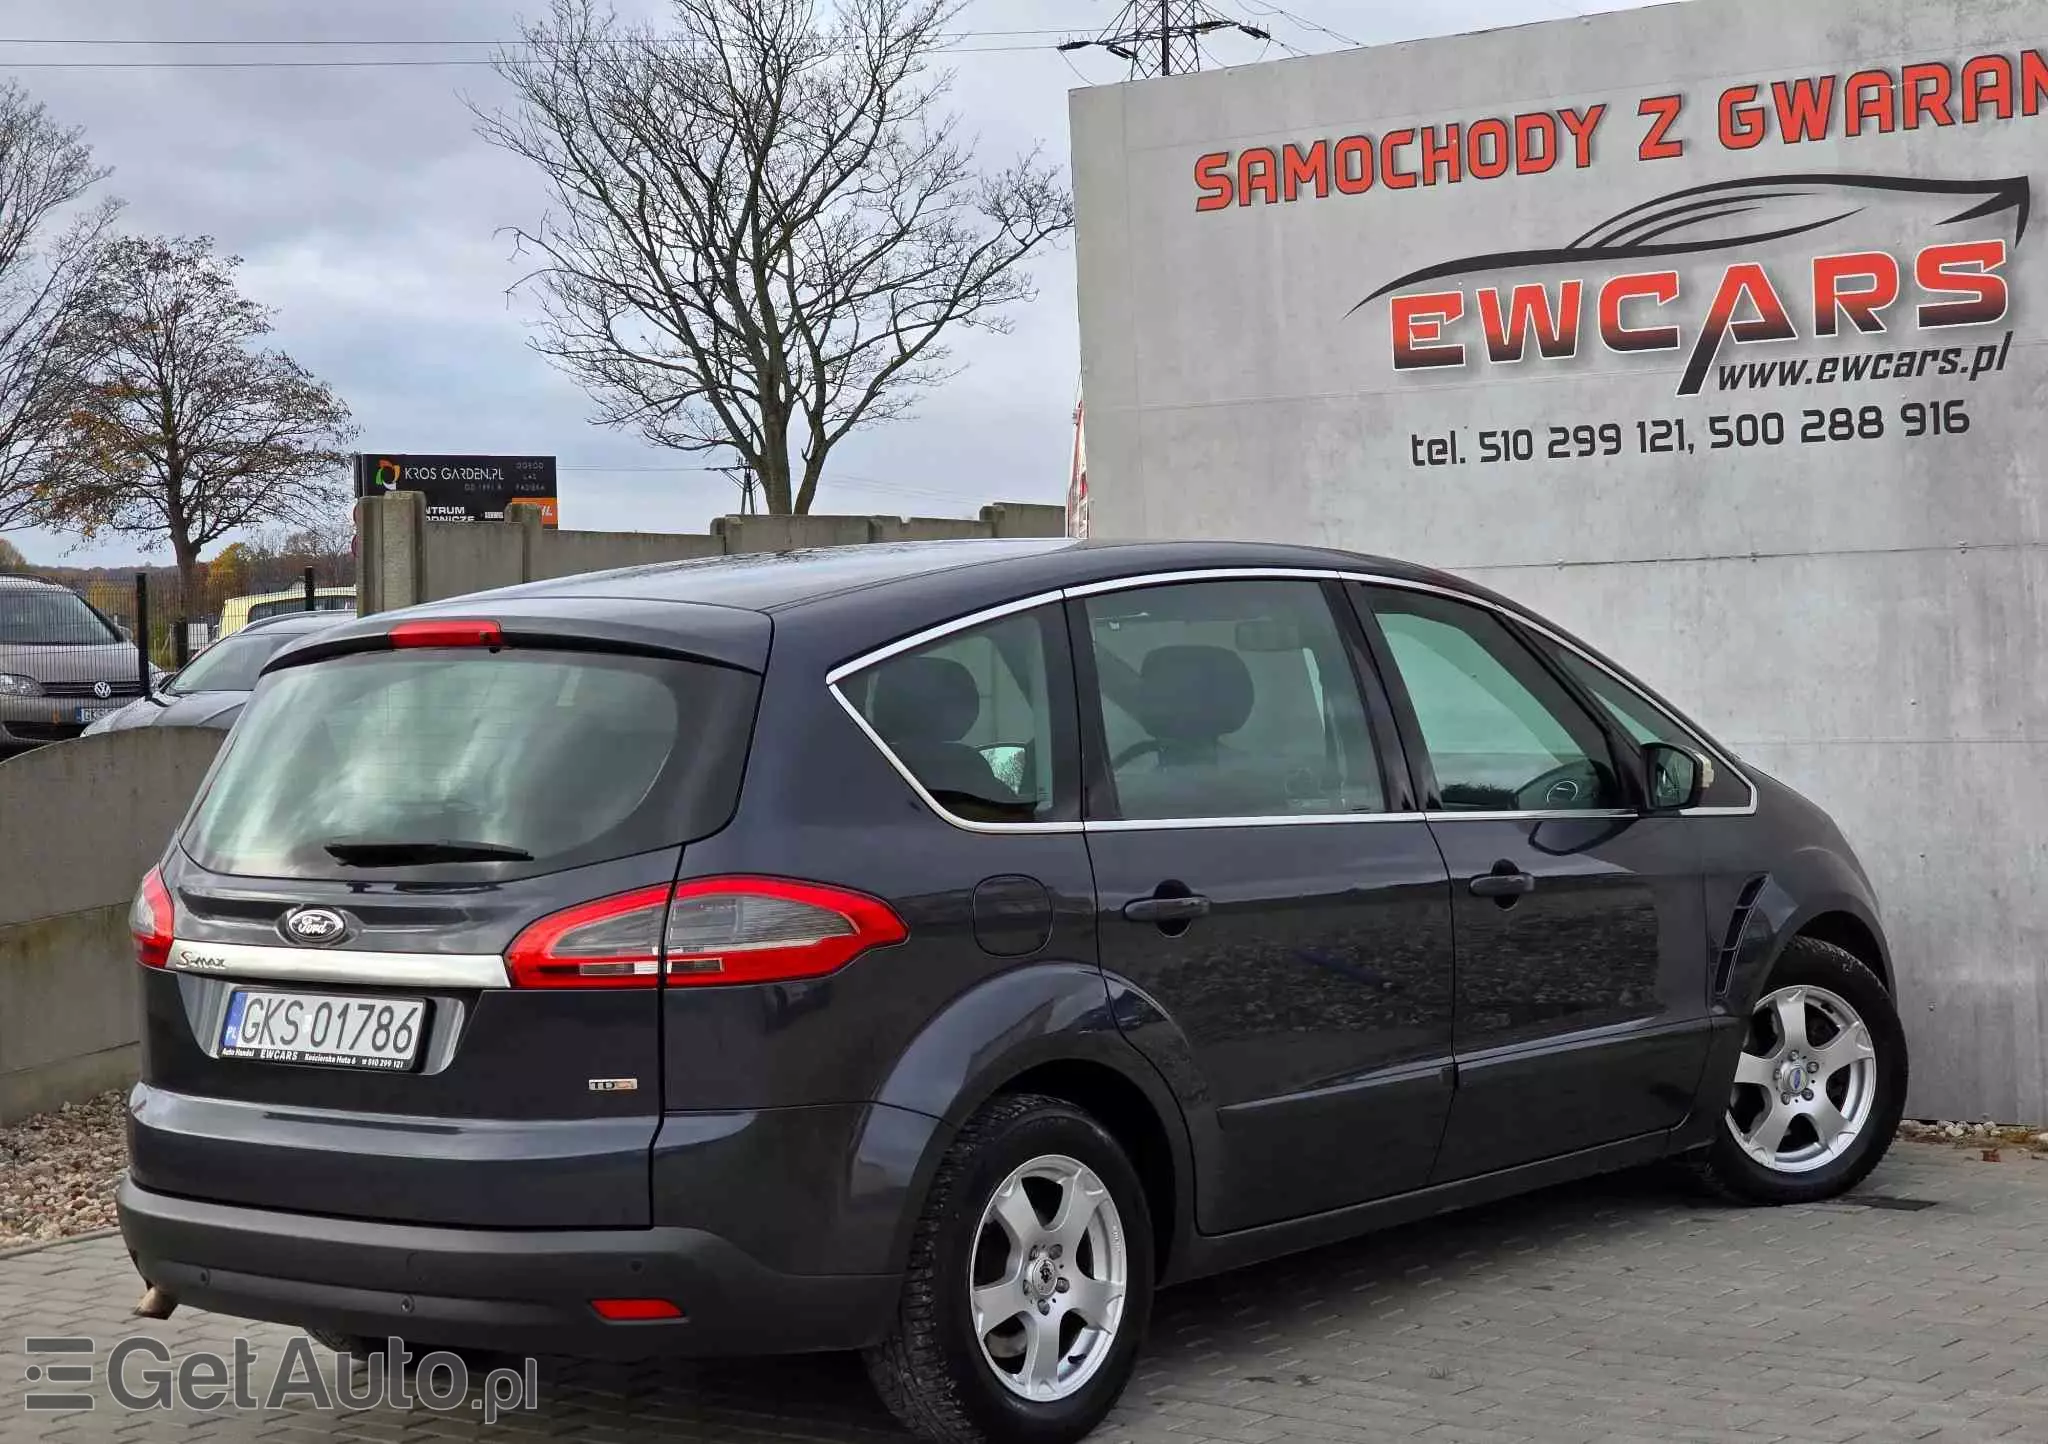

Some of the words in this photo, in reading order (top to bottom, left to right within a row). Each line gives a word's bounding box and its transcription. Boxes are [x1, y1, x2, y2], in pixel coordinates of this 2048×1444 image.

[1194, 104, 1607, 212] SAMOCHODY
[1637, 93, 1686, 162] Z
[1389, 239, 2007, 396] EWCARS
[1718, 330, 2014, 391] www.ewcars.pl
[1411, 430, 1466, 467] tel.
[1478, 429, 1534, 463] 510
[1547, 423, 1623, 459] 299
[1636, 418, 1695, 455] 121,
[1708, 412, 1785, 449] 500
[1800, 405, 1885, 443] 288
[1900, 399, 1970, 437] 916
[404, 467, 437, 480] KROS
[441, 467, 505, 480] GARDEN.PL
[425, 506, 465, 515] NTRUM
[298, 915, 334, 935] Ford
[225, 1025, 238, 1041] PL
[240, 997, 304, 1047] GKS
[310, 1001, 419, 1054] 01786
[260, 1048, 298, 1061] EWCARS
